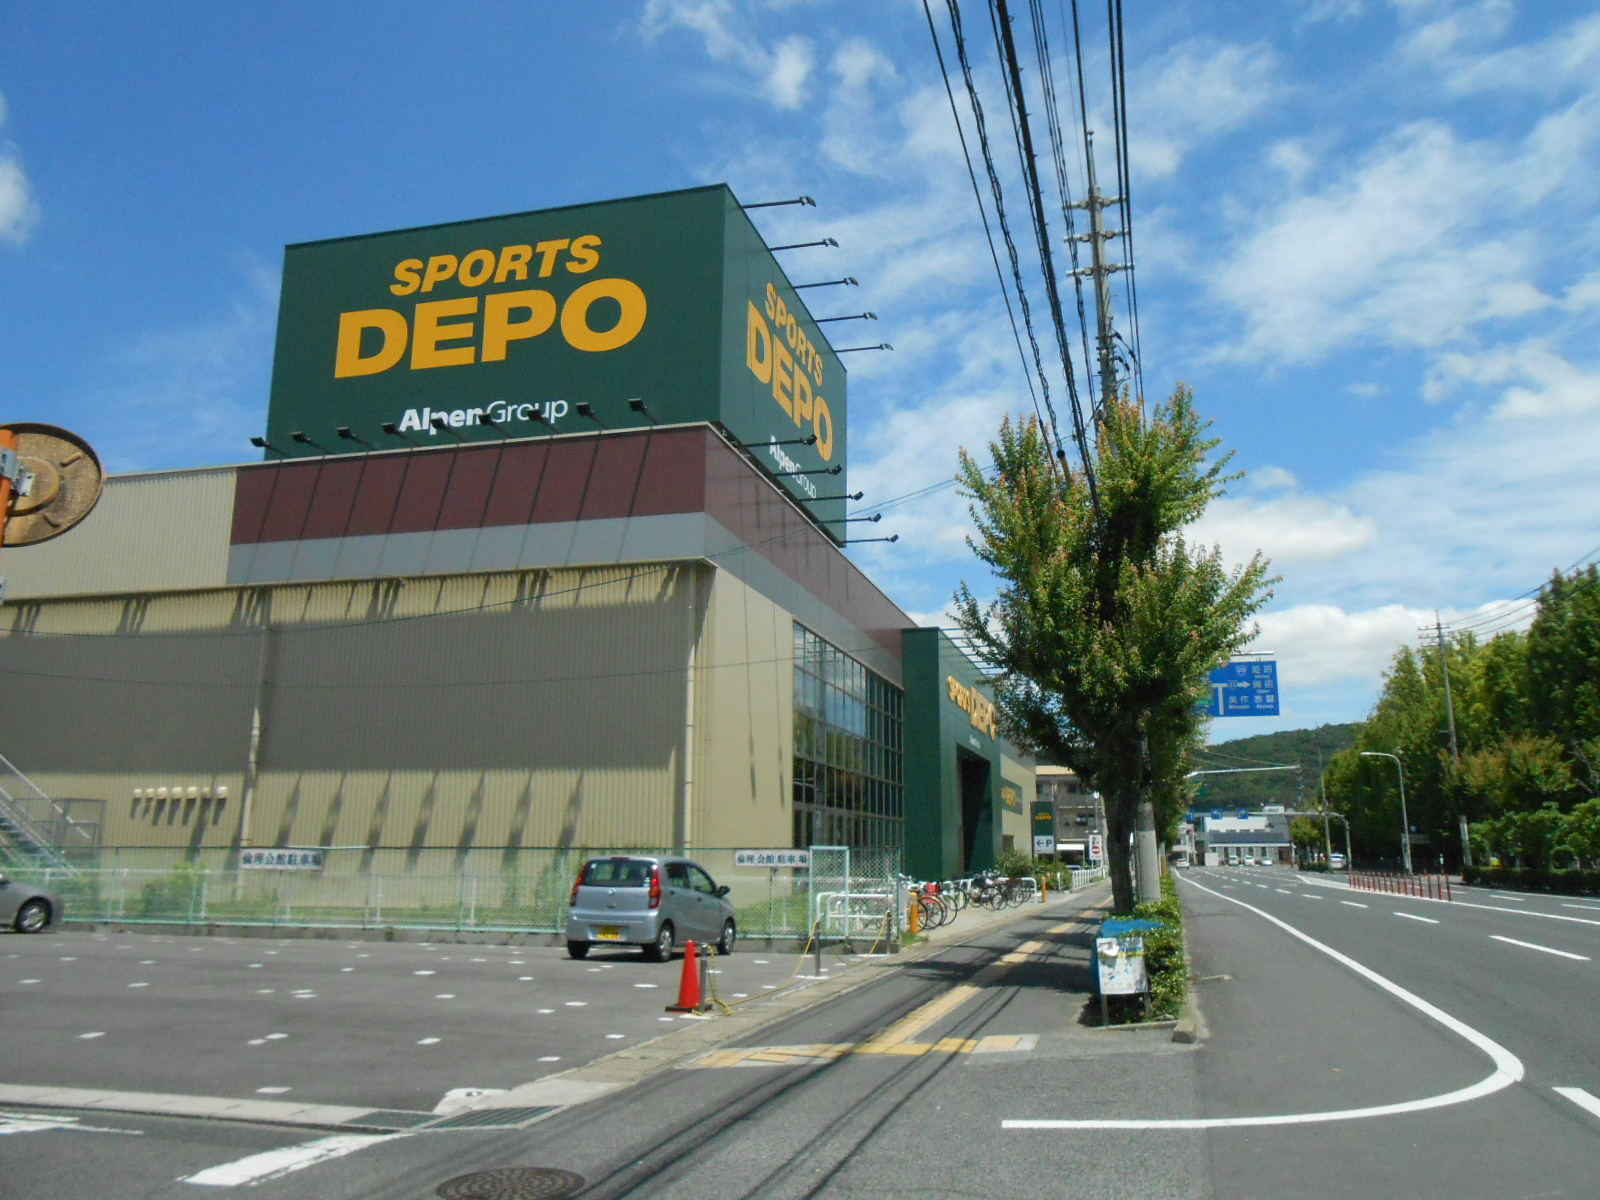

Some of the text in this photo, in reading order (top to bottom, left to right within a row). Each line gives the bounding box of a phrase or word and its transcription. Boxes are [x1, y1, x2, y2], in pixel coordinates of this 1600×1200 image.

[389, 234, 602, 297] SPORTS
[334, 277, 648, 379] DEPO
[765, 282, 824, 387] SPORTS
[746, 299, 834, 462] DEPO
[1046, 839, 1053, 847] P
